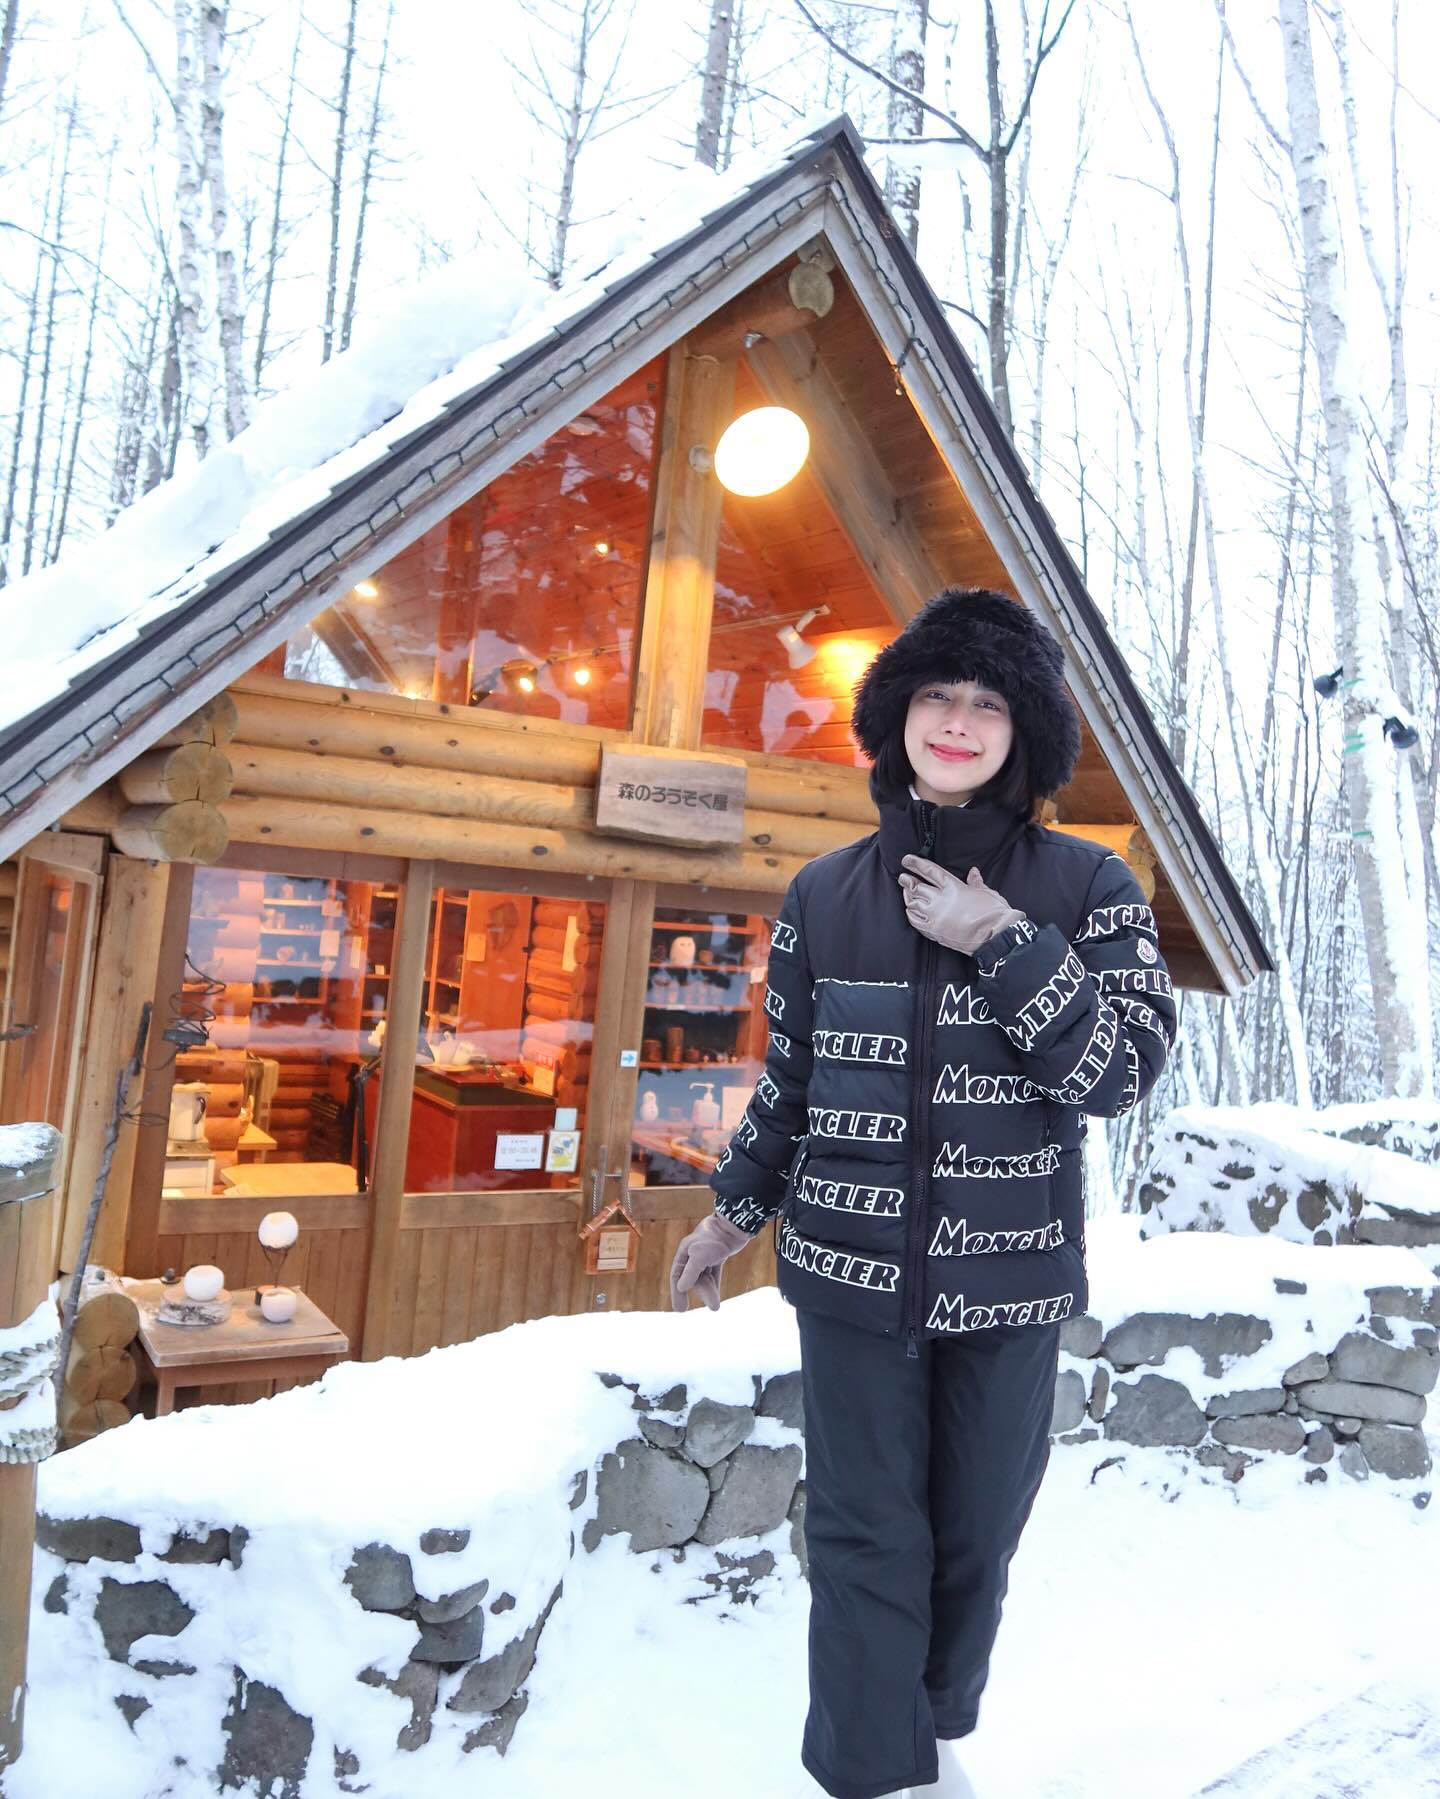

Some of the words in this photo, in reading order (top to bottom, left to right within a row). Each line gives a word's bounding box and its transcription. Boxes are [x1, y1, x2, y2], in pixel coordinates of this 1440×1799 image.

[617, 782, 728, 811] 森のろうそく屋
[797, 1175, 905, 1217] NCLER
[926, 1293, 1074, 1333] MONCLER
